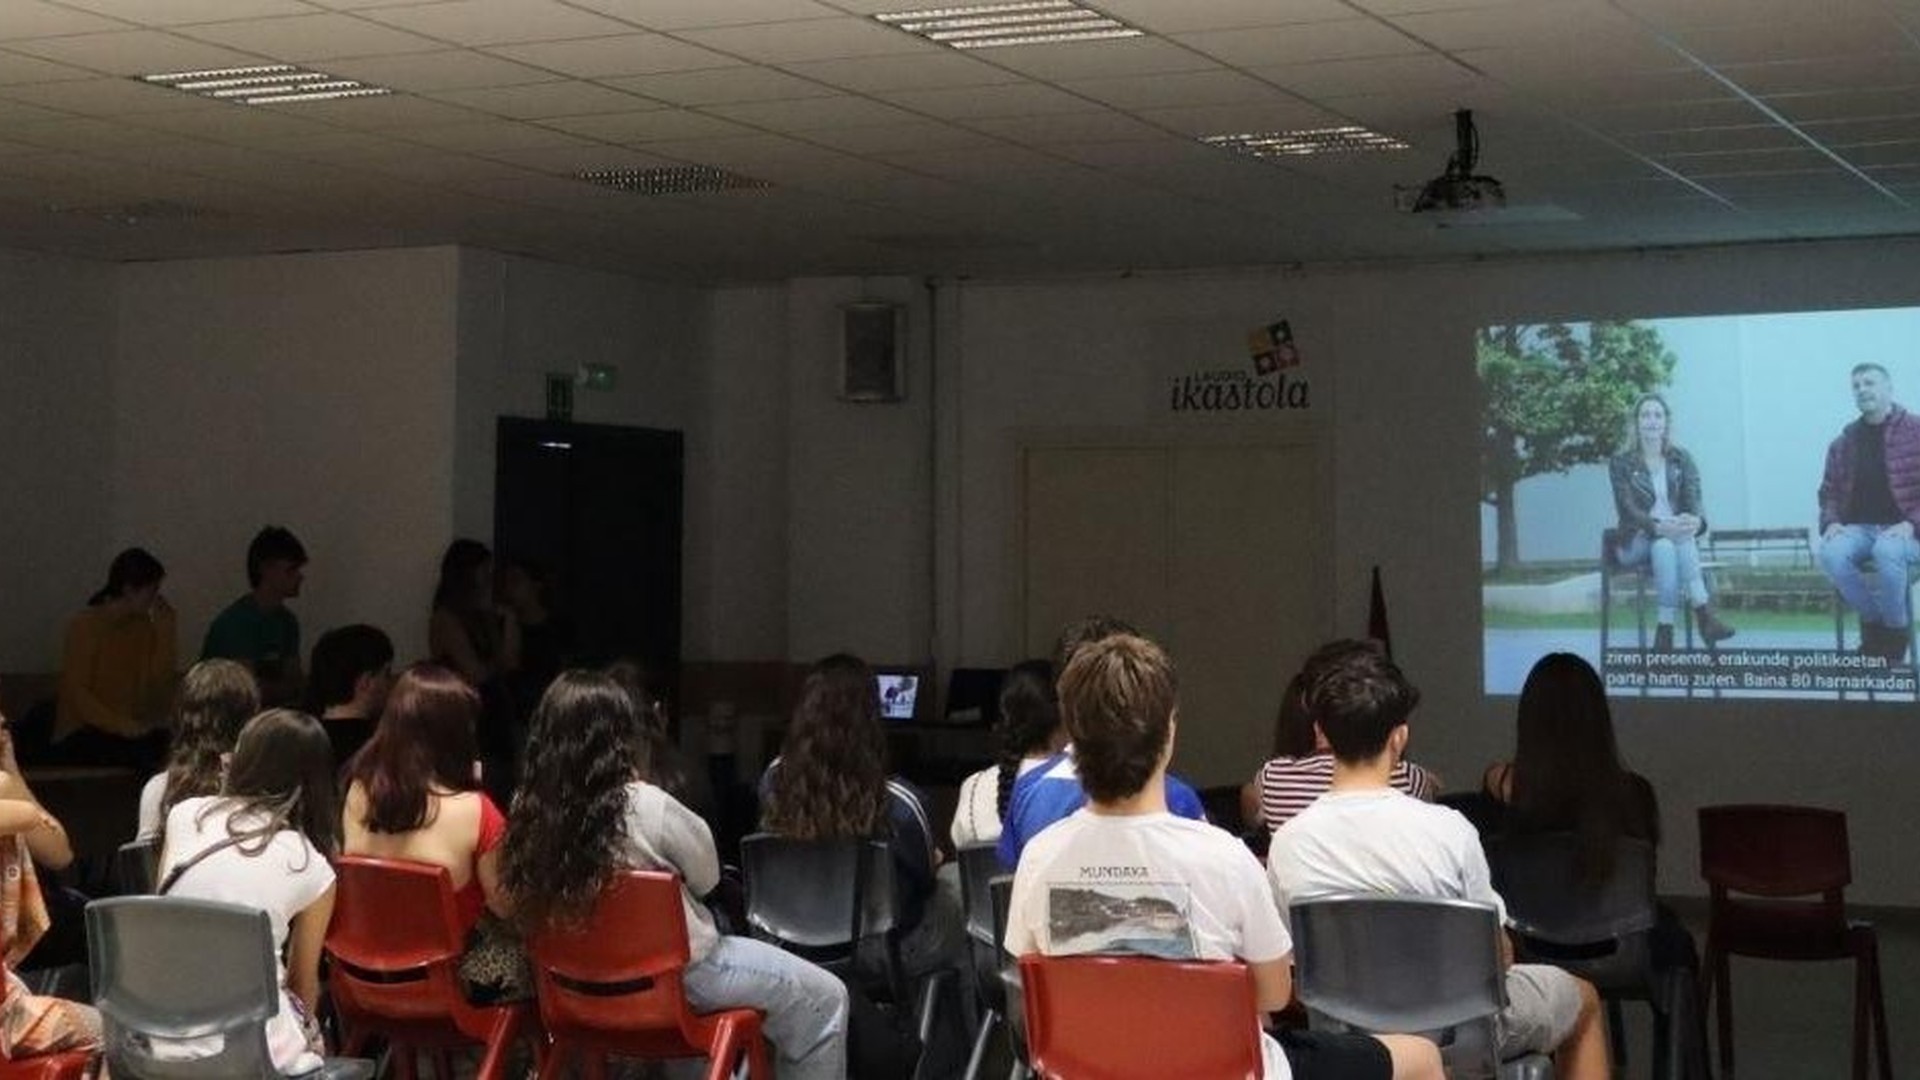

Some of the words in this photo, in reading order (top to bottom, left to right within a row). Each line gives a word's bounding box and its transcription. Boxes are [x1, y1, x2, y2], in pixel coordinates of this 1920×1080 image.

[1171, 374, 1311, 411] ikastola
[1606, 651, 1642, 665] ziren
[1646, 652, 1716, 668] presente,
[1718, 650, 1789, 667] erakunde
[1794, 652, 1888, 669] politikoetan
[1606, 672, 1646, 687] parte
[1648, 671, 1689, 687] hartu
[1693, 673, 1739, 688] zuten.
[1744, 671, 1788, 688] Baina
[1791, 672, 1812, 689] 80
[1079, 866, 1149, 879] MUNDAKA
